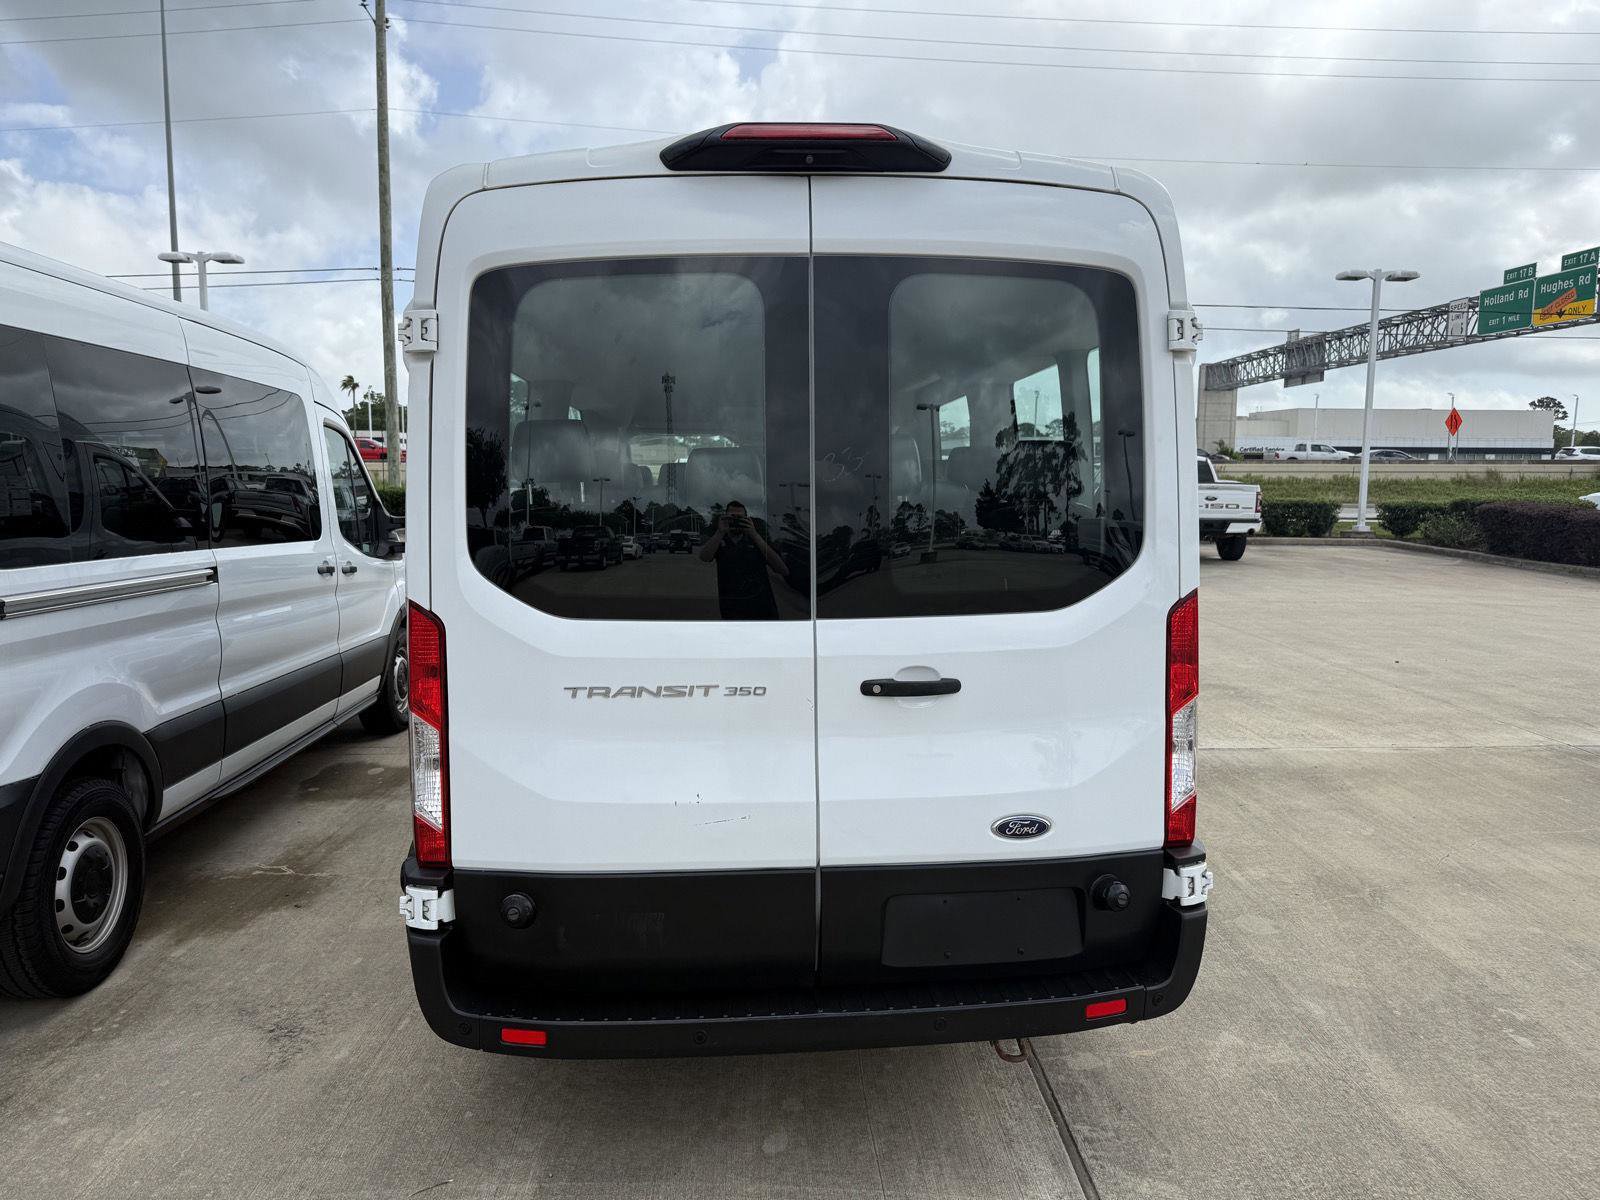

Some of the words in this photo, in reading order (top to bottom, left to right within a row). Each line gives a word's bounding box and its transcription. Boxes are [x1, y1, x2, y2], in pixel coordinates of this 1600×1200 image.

[1564, 257, 1576, 266] EXIT
[1506, 272, 1517, 280] EXIT
[1540, 279, 1574, 294] Hughes
[1578, 273, 1591, 285] Rd
[1484, 291, 1515, 306] Holland
[1518, 288, 1529, 299] Rd
[1567, 304, 1587, 315] ONLY
[1488, 318, 1499, 326] EXIT
[1502, 316, 1506, 324] 1
[1508, 314, 1520, 322] MILE
[563, 684, 720, 699] TRANSIT
[723, 686, 767, 697] 350
[1005, 820, 1039, 835] Ford
